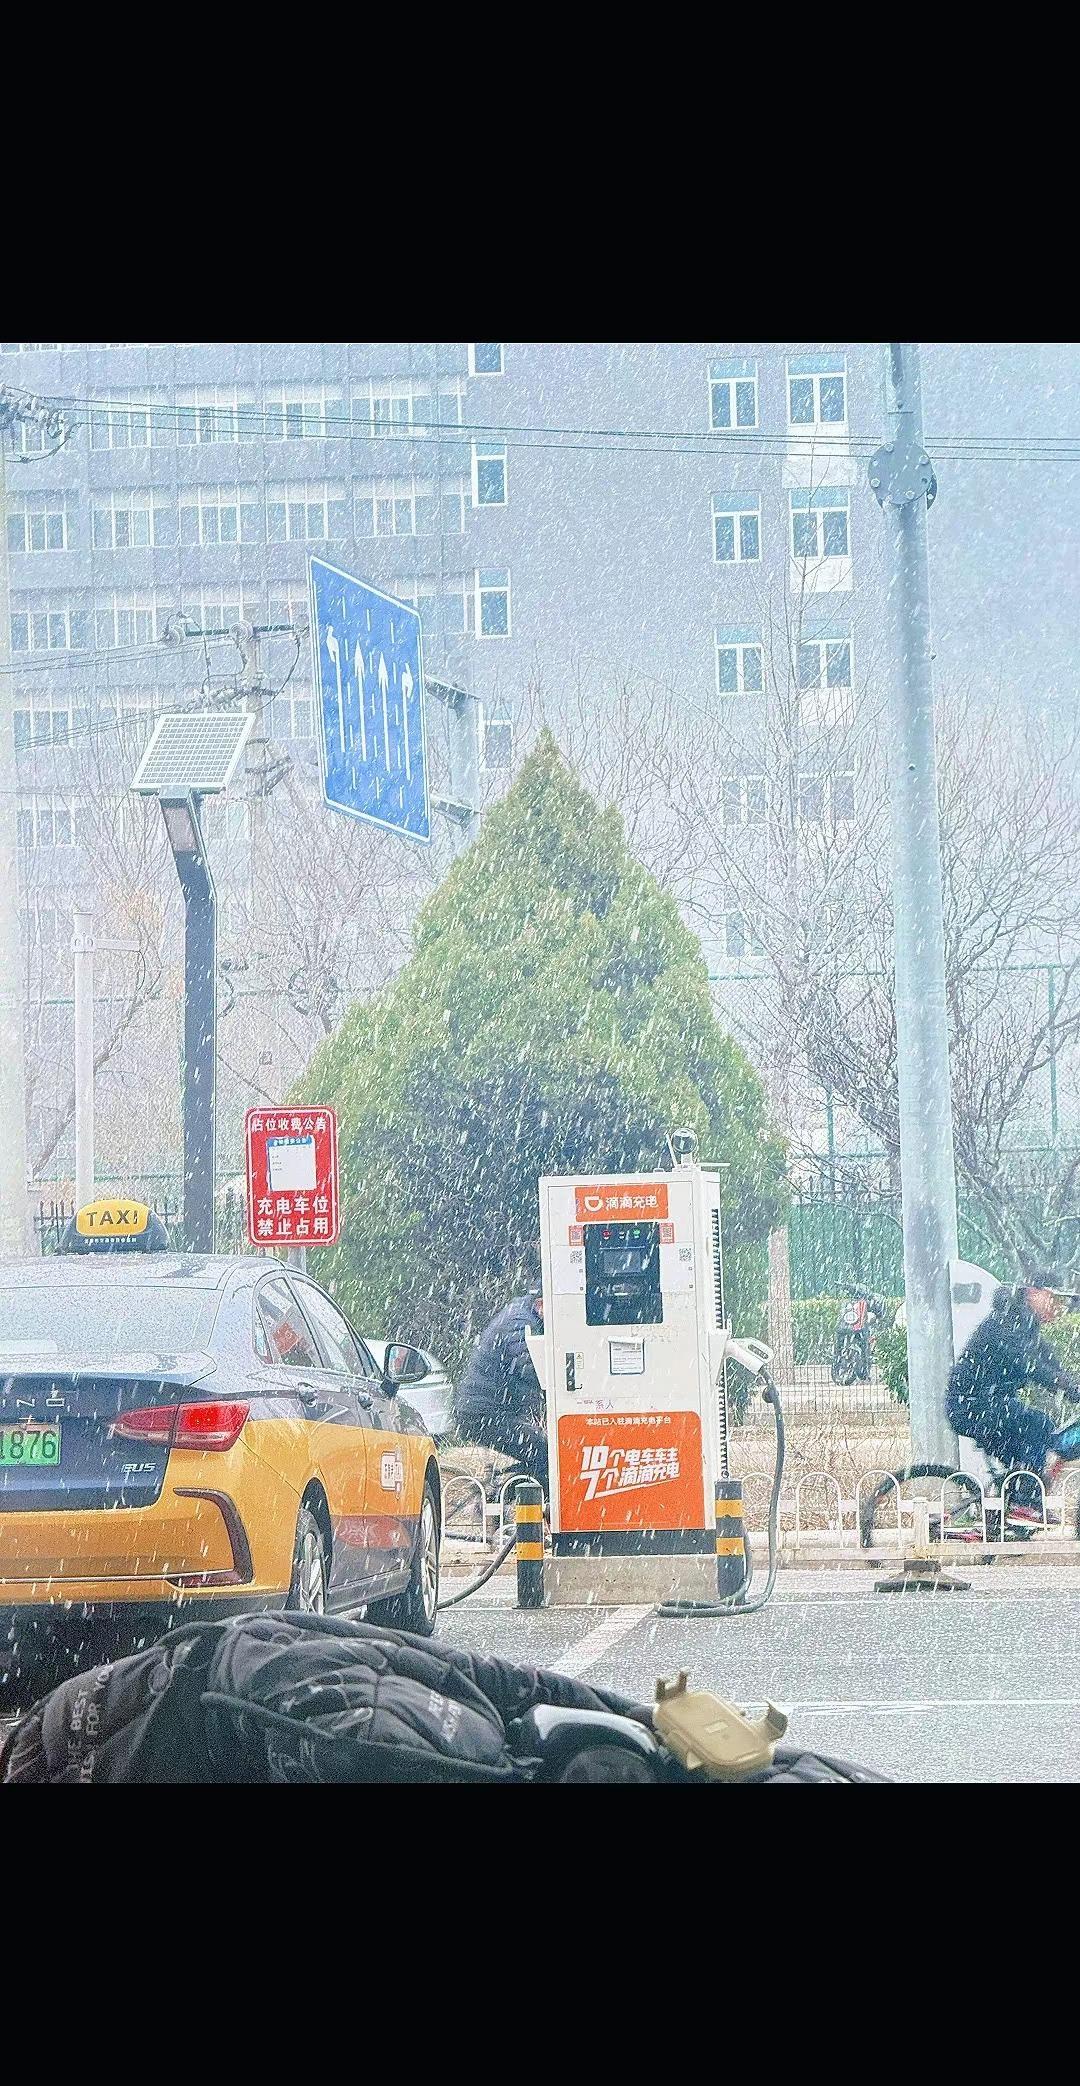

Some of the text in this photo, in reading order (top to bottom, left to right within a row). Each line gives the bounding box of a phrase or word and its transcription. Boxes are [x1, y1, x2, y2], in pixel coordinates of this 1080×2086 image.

[251, 1116, 327, 1133] 占位收费公告
[257, 1195, 330, 1216] 充电车位
[605, 1194, 659, 1210] 滴滴充电
[86, 1209, 138, 1227] TAXI
[257, 1217, 330, 1237] 禁止占用
[580, 1462, 680, 1501] 7个滴滴充电
[70, 1690, 88, 1731] BEST
